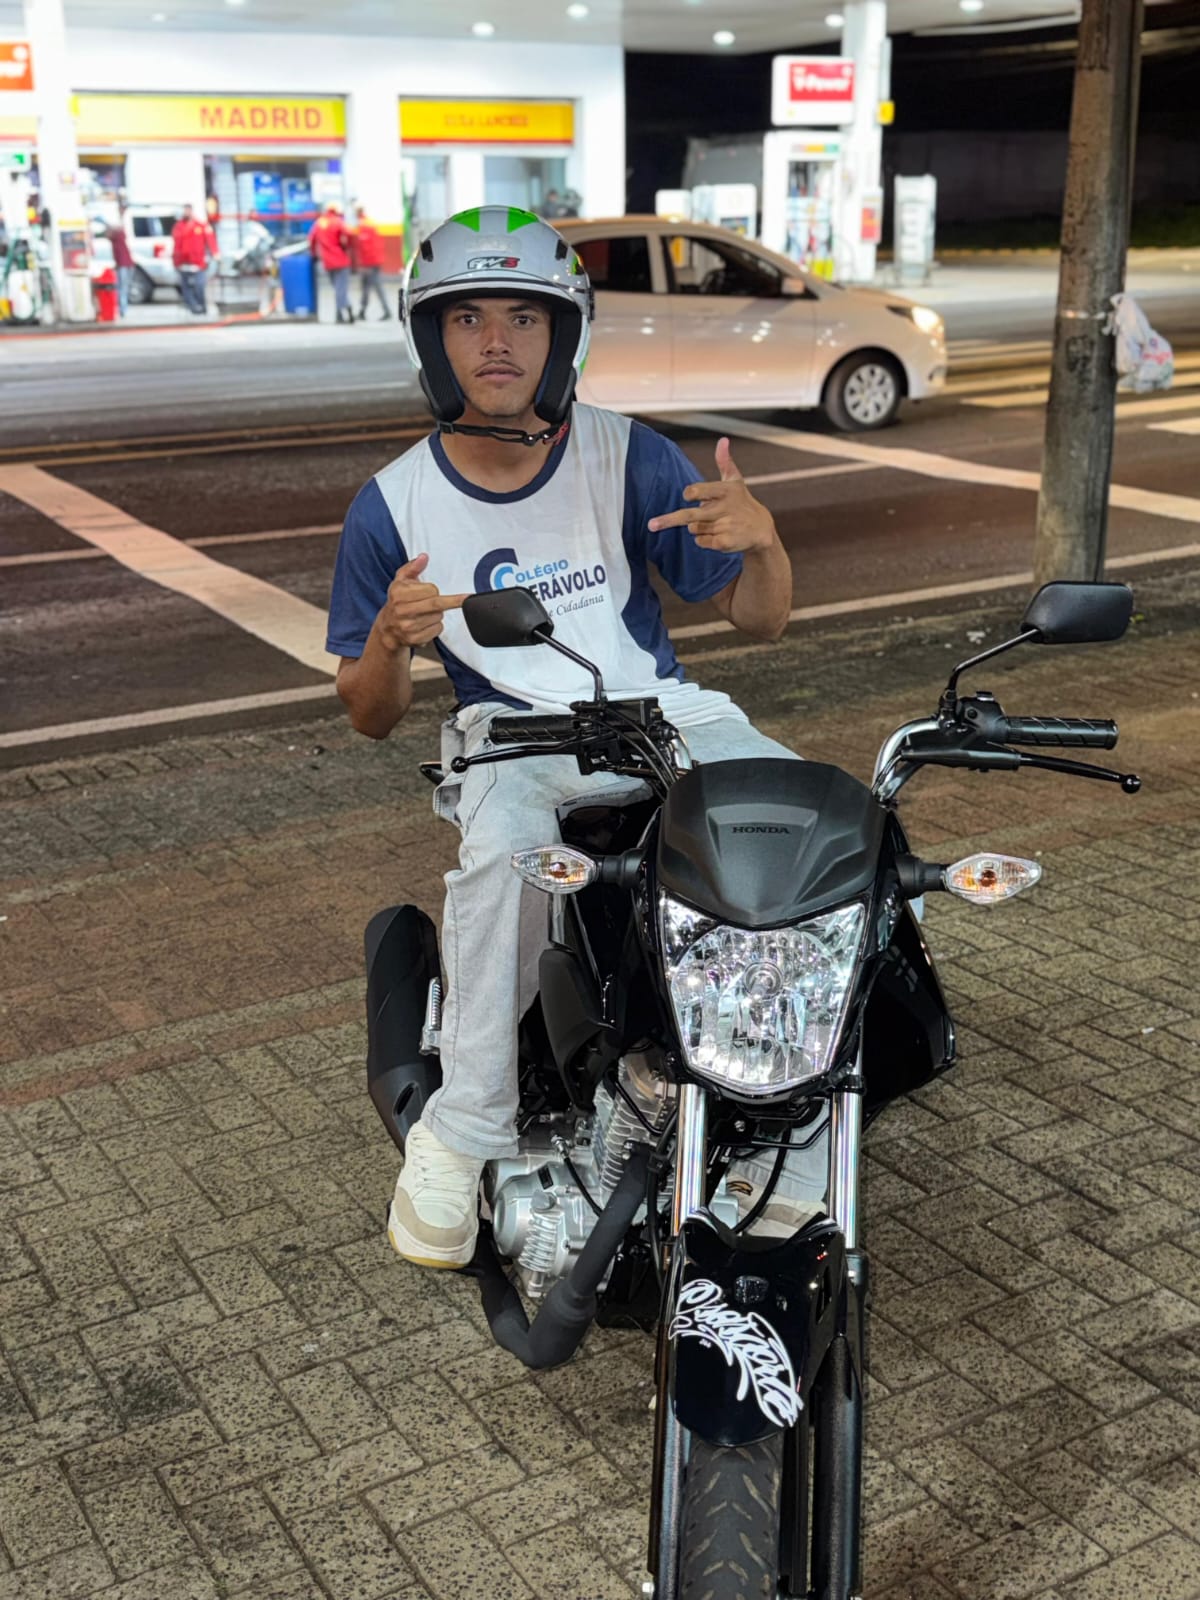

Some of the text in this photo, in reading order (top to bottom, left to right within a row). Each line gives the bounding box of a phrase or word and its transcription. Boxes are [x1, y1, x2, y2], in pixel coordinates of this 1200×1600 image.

[200, 106, 323, 130] MADRID
[527, 564, 606, 602] ERÁVOLO
[556, 594, 604, 617] Cidadania
[731, 826, 791, 834] HONDA
